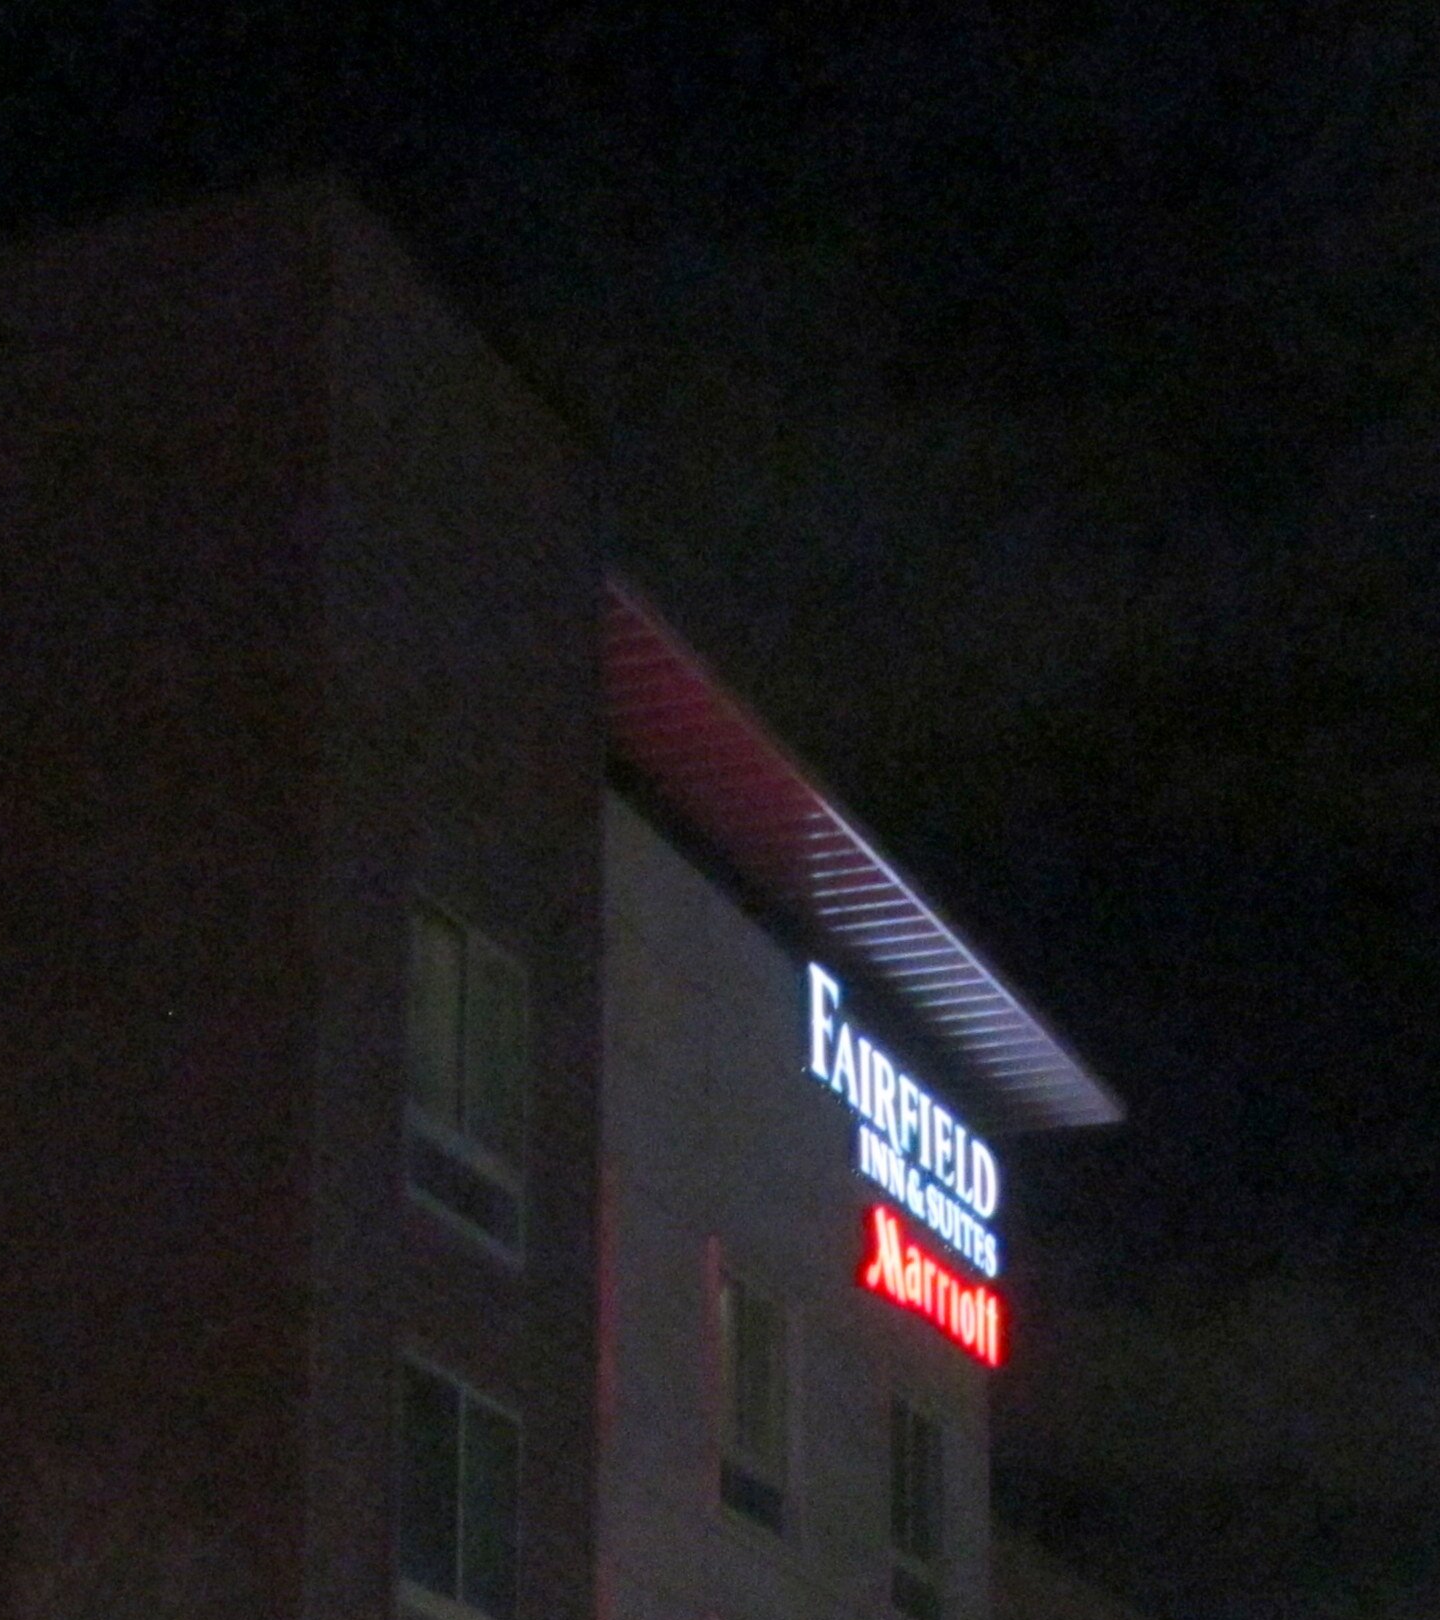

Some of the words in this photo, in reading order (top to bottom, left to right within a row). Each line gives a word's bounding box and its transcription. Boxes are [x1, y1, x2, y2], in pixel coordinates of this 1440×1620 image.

[809, 962, 997, 1218] FAIRFIELD
[860, 1124, 906, 1202] INN
[905, 1166, 925, 1217] &
[925, 1185, 997, 1278] SUITES
[865, 1205, 1000, 1368] Marriott
